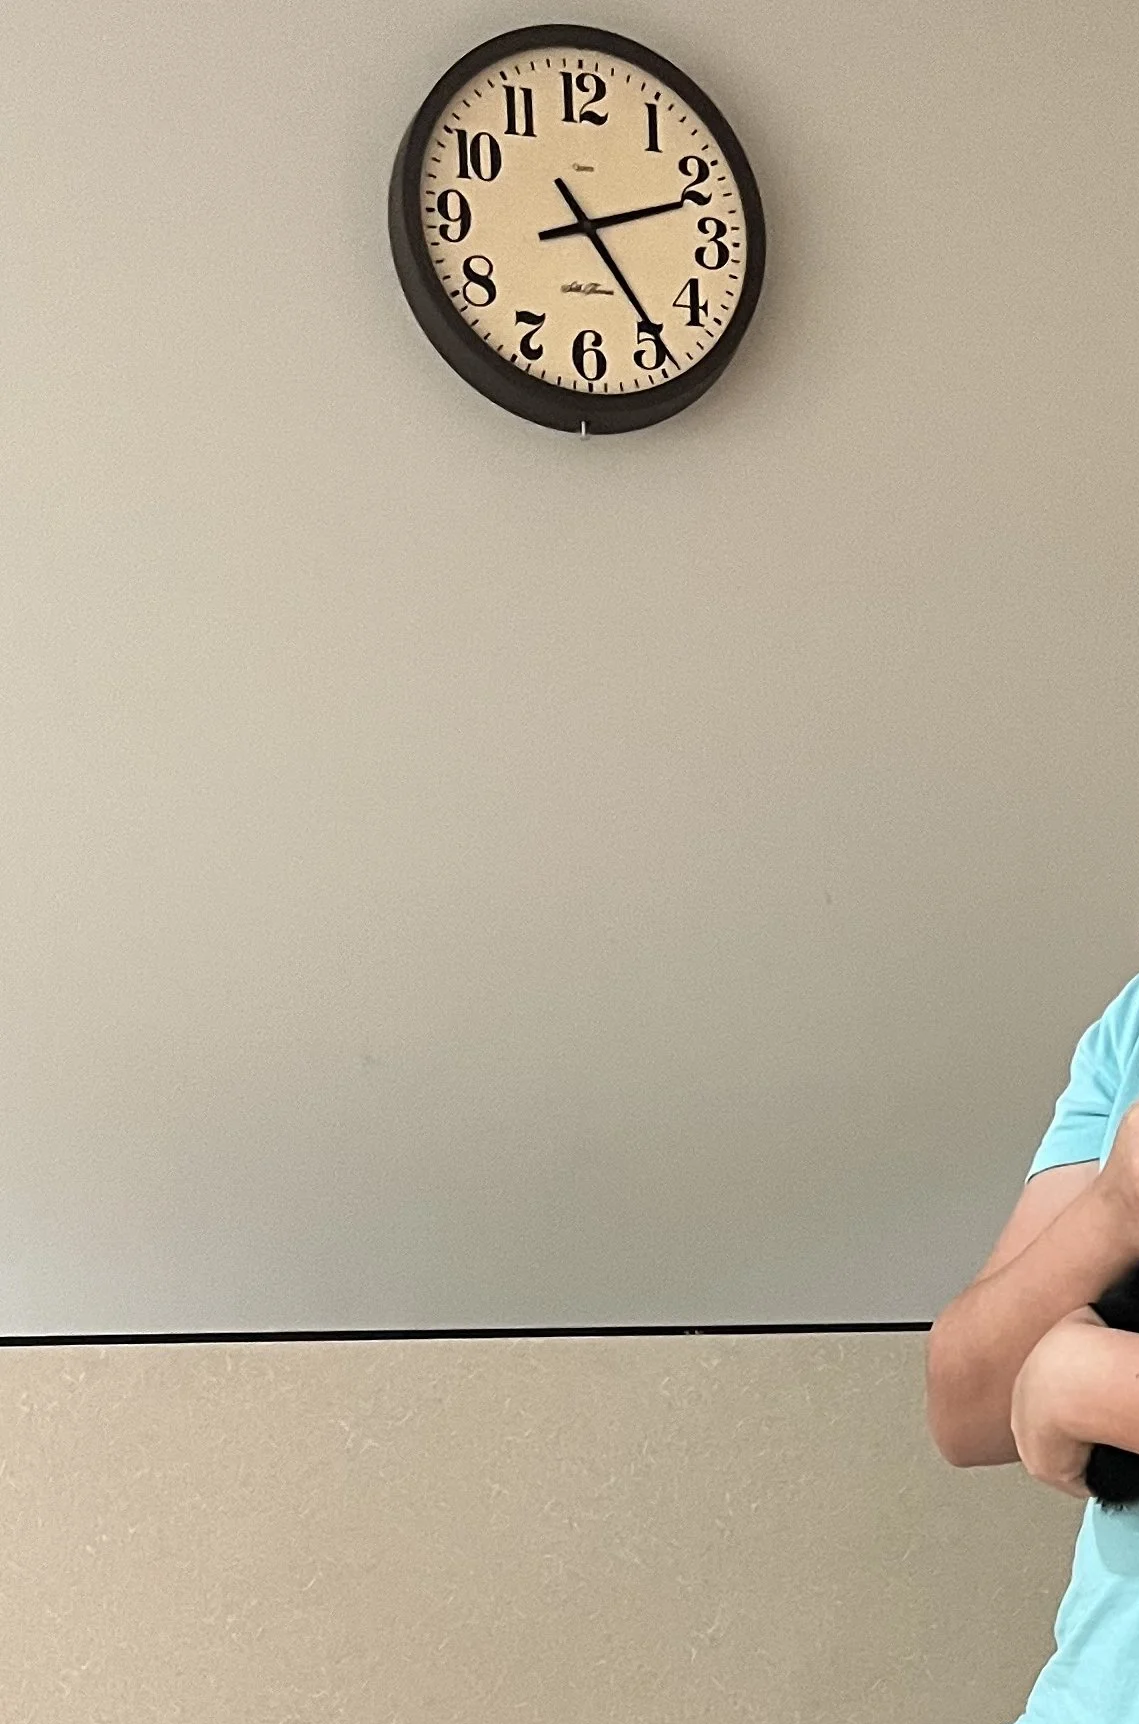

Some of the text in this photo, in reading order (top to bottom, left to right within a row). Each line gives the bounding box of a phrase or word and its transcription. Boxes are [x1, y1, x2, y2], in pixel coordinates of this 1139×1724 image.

[502, 85, 537, 137] 11
[560, 71, 609, 126] 12
[644, 102, 663, 152] 1
[456, 128, 502, 182] 10
[678, 155, 712, 206] 2
[436, 189, 472, 242] 9
[694, 217, 730, 270] 3
[462, 255, 497, 307] 8
[672, 278, 709, 327] 4
[515, 310, 546, 361] 7
[571, 329, 607, 381] 6
[633, 320, 666, 370] 5
